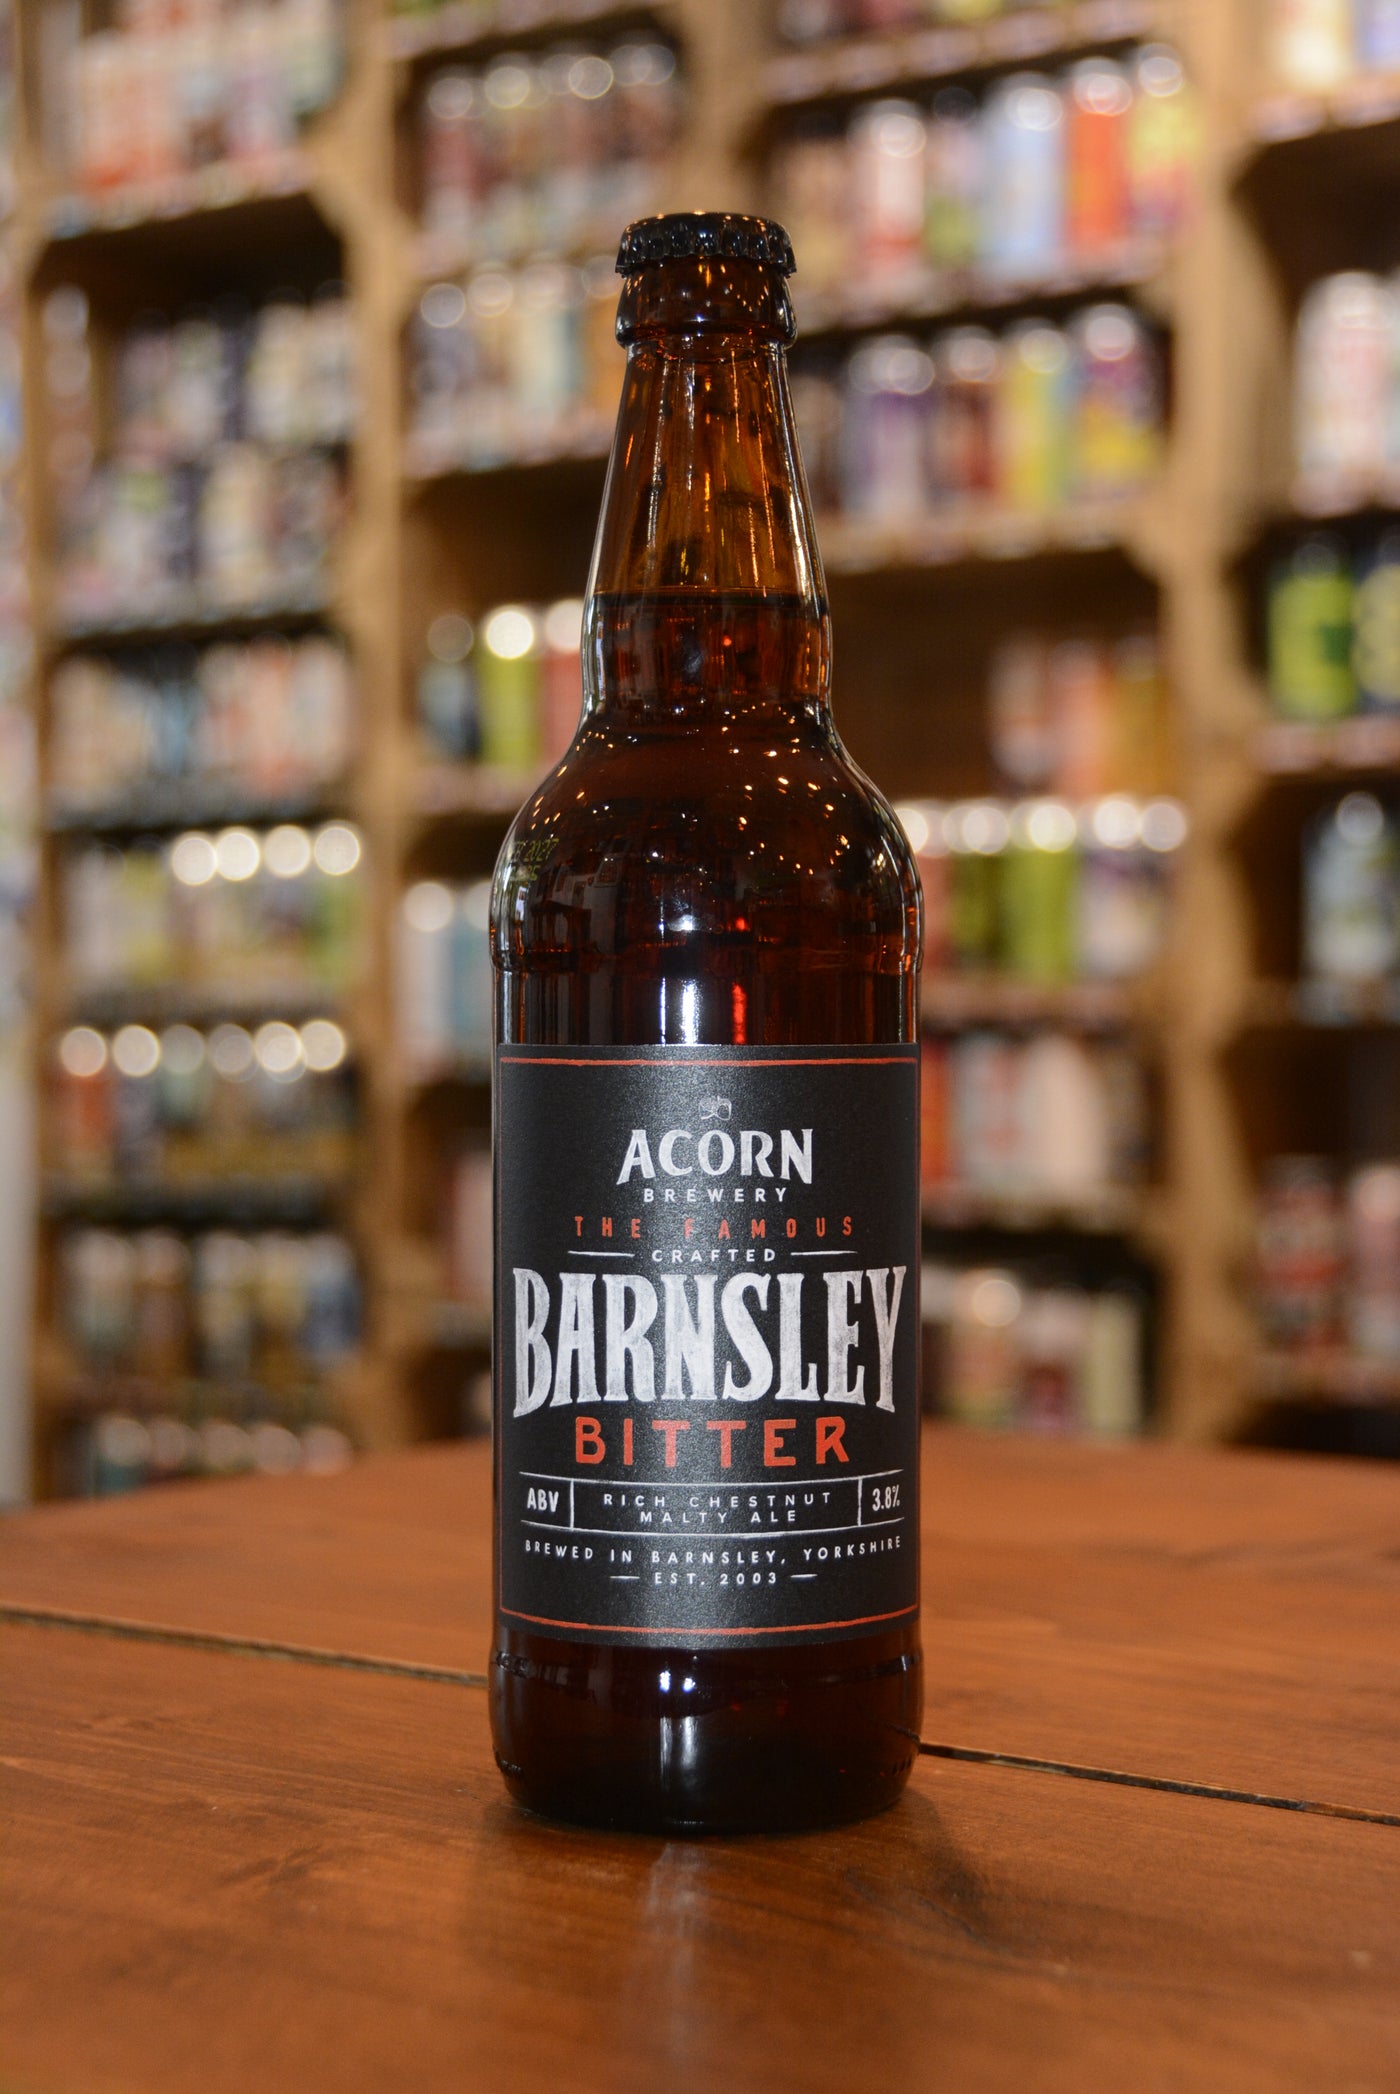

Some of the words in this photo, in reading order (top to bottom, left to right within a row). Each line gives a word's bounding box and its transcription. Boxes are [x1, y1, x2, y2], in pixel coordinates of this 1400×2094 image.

[616, 1128, 813, 1185] ACORN
[643, 1187, 787, 1203] BREWERY
[574, 1215, 641, 1239] THE
[684, 1215, 853, 1240] FAMOUS
[651, 1249, 776, 1263] CRAFTED
[512, 1265, 907, 1418] BARNSLEY
[575, 1415, 850, 1468] BITTER
[526, 1487, 559, 1513] ABV
[603, 1493, 666, 1508] RICH
[689, 1492, 831, 1508] CHESTNUT
[872, 1485, 901, 1513] 3.8%
[640, 1512, 729, 1524] MALTY
[750, 1510, 797, 1523] ALE
[525, 1539, 594, 1560] BREWED
[610, 1549, 633, 1563] IN
[651, 1550, 787, 1566] BARNSLEY,
[803, 1534, 901, 1562] YORKSHIRE
[654, 1572, 706, 1586] EST.
[719, 1572, 778, 1586] 2003
